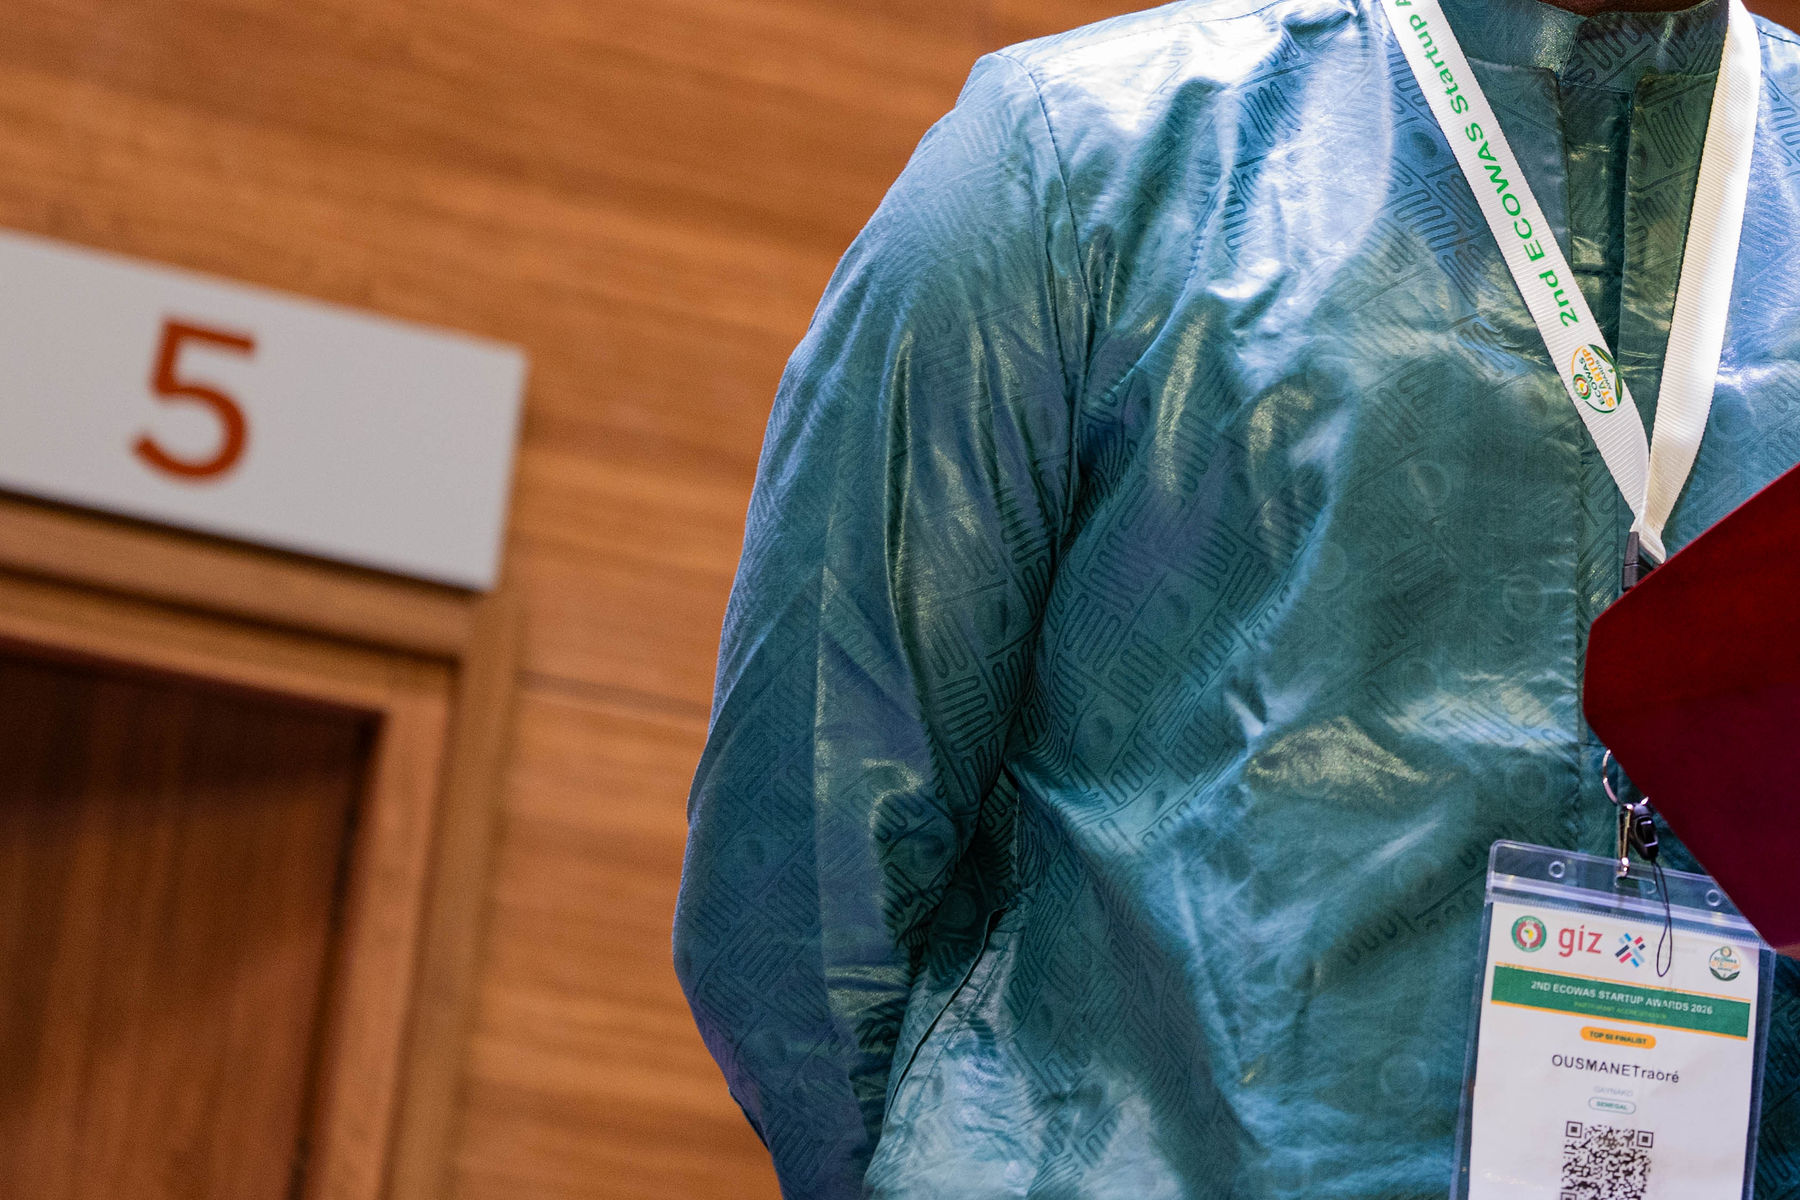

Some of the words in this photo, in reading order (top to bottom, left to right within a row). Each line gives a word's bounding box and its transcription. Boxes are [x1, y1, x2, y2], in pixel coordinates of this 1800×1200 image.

[1409, 13, 1469, 114] Startup
[1465, 122, 1545, 261] ECOWAS
[1539, 270, 1579, 327] 2nd
[132, 315, 256, 484] 5
[1558, 924, 1602, 957] giz
[1530, 980, 1550, 992] 2ND
[1552, 983, 1596, 998] ECOWAS
[1598, 990, 1644, 1005] STARTUP
[1645, 998, 1689, 1011] AWARDS
[1589, 1030, 1604, 1039] TOP
[1615, 1034, 1647, 1045] FINALIST
